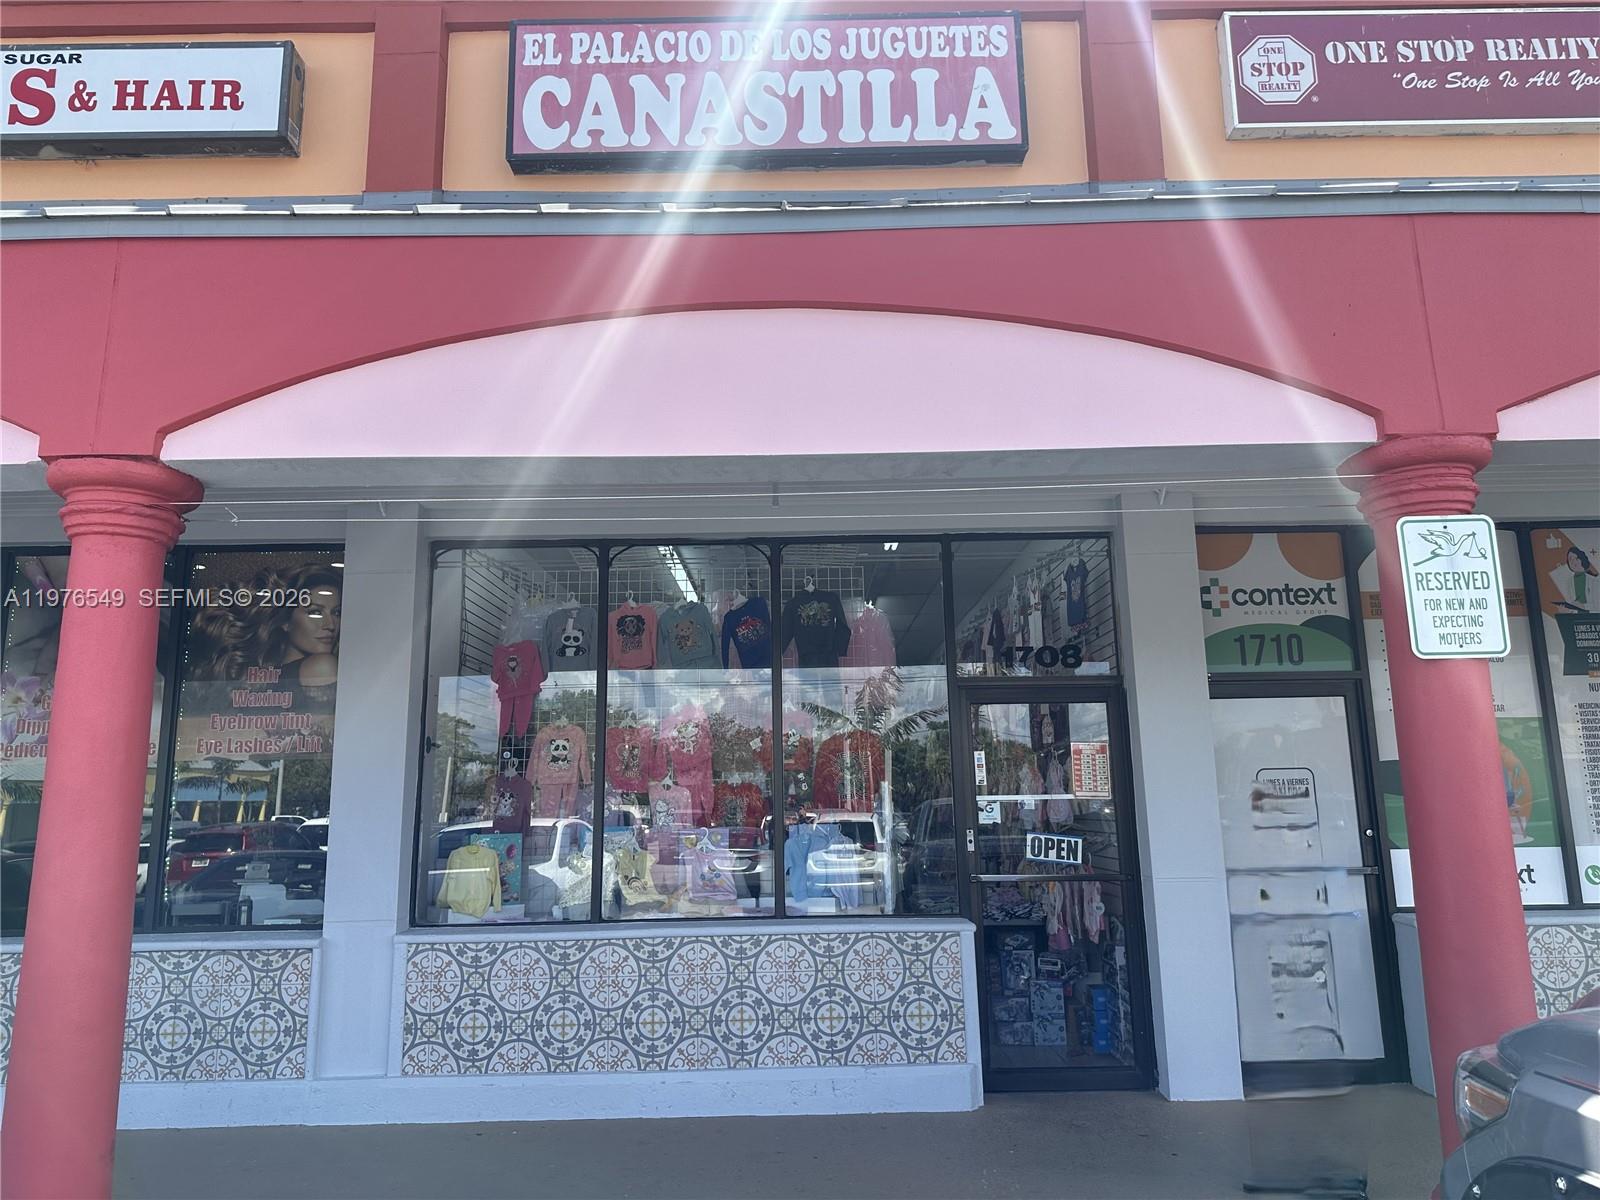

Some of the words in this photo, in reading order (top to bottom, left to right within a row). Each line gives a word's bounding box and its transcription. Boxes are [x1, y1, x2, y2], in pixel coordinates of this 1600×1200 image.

[523, 32, 562, 65] EL
[570, 30, 712, 64] PALACIO
[720, 30, 761, 62] DE
[769, 28, 832, 61] LOS
[840, 25, 1009, 59] JUGUETES
[1263, 47, 1284, 55] ONE
[1325, 41, 1388, 64] ONE
[1396, 39, 1474, 62] STOP
[1484, 37, 1600, 61] REALTY
[3, 53, 83, 65] SUGAR
[1250, 62, 1305, 77] STOP
[1260, 83, 1299, 91] REALTY
[1445, 71, 1491, 91] Stop
[1498, 71, 1519, 87] Is
[1525, 70, 1560, 88] All
[68, 80, 97, 112] &
[112, 79, 244, 112] HAIR
[522, 66, 1017, 150] CANASTILLA
[1415, 571, 1490, 591] RESERVED
[1232, 583, 1337, 606] context
[1424, 598, 1442, 611] FOR
[1445, 598, 1465, 610] NEW
[1469, 597, 1488, 610] AND
[1433, 615, 1484, 628] EXPECTING
[1438, 632, 1482, 645] MOTHERS
[1001, 644, 1082, 670] 1708
[1233, 633, 1304, 666] 1710
[248, 667, 281, 683] Hair
[232, 690, 293, 708] Waxing
[210, 714, 278, 732] Eyebrow
[280, 713, 313, 729] Tint
[196, 737, 223, 755] Eye
[226, 737, 282, 753] Lashes
[1031, 836, 1079, 861] OPEN
